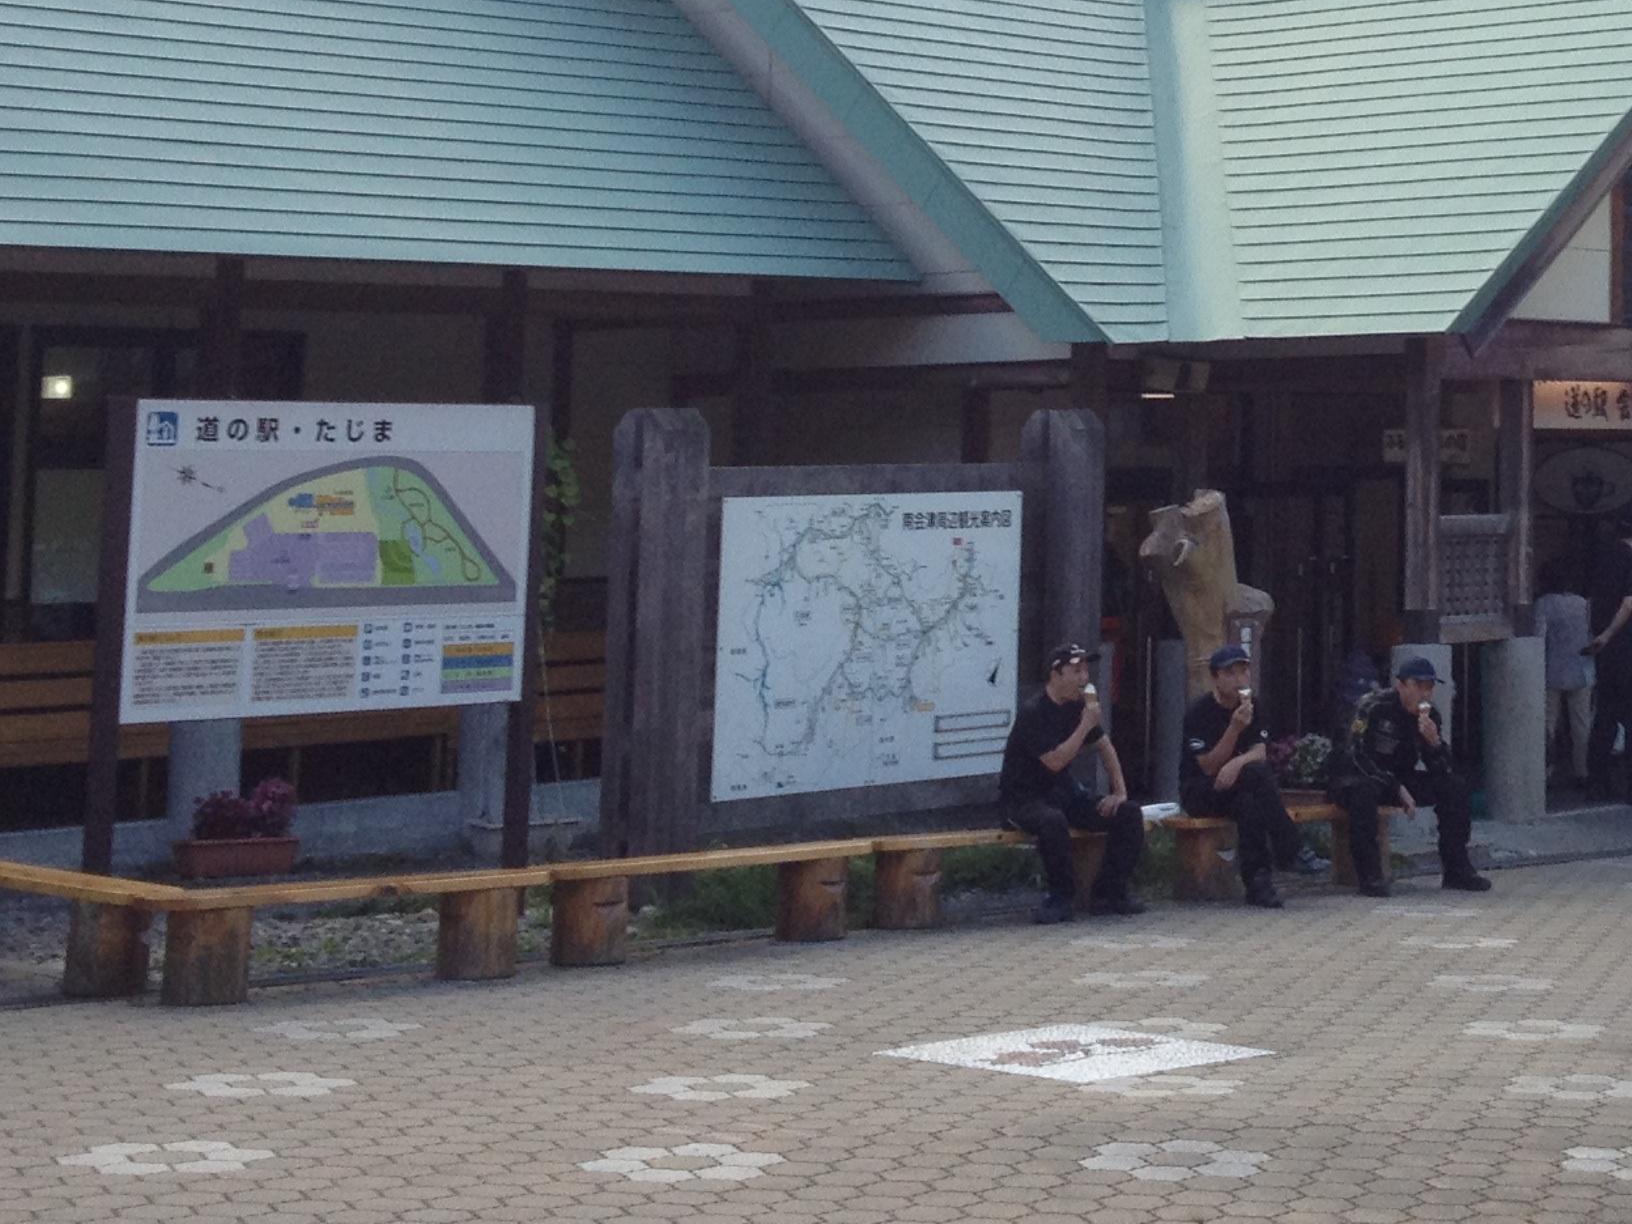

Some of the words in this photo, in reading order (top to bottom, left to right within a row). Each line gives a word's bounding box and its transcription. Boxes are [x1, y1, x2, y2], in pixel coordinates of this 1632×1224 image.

[196, 416, 394, 443] 道の駅・たじま
